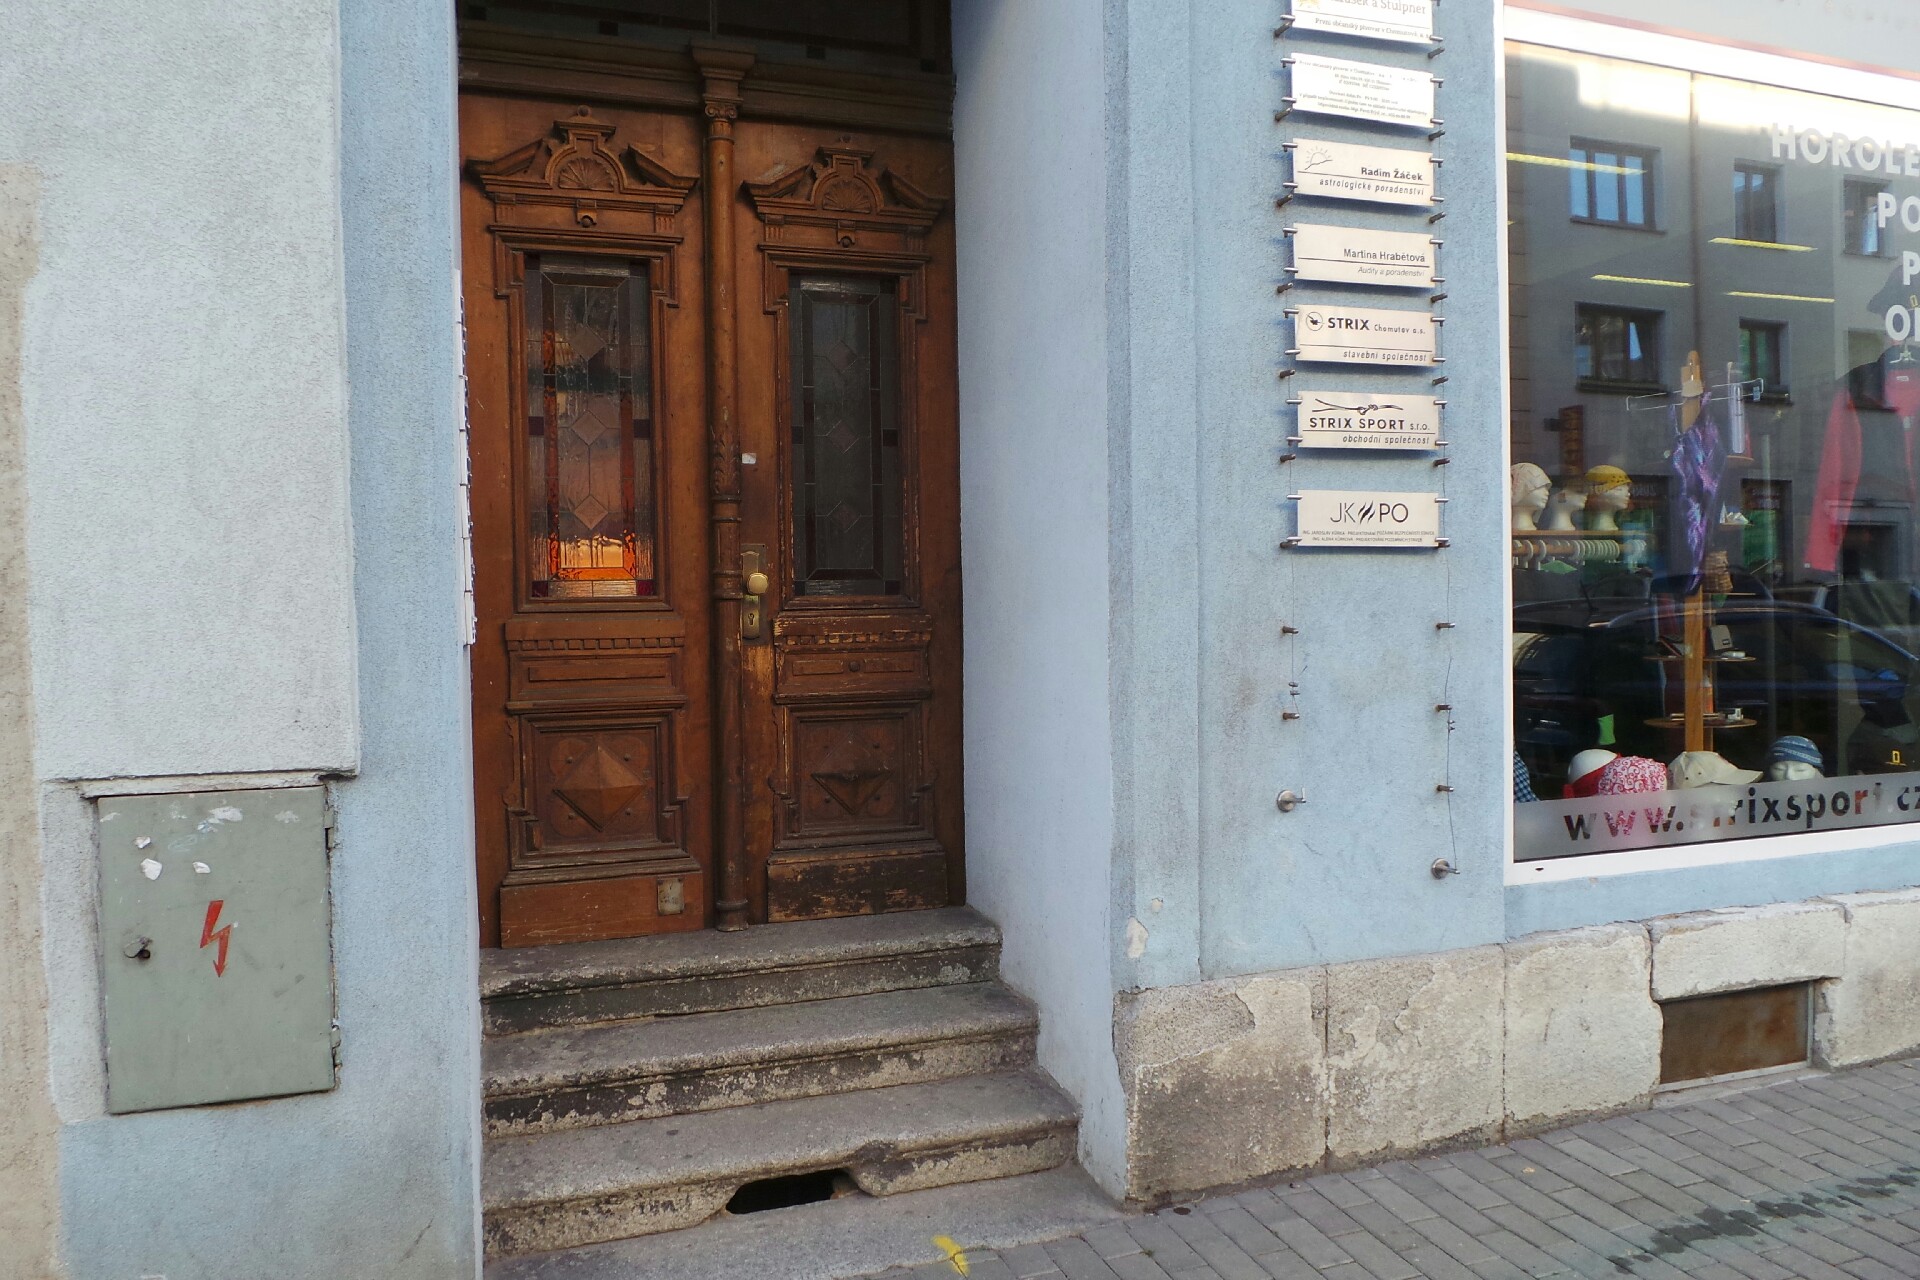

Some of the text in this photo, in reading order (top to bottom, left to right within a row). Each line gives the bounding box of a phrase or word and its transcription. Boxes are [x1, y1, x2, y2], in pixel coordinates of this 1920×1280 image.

[1771, 123, 1920, 177] HOROLE
[1360, 167, 1423, 181] Radim Žáček
[1319, 179, 1425, 196] astrologické poradenství
[1877, 192, 1920, 233] PO
[1343, 248, 1377, 260] Martina
[1327, 317, 1370, 331] STRIX
[1374, 323, 1410, 334] Chomutov
[1343, 350, 1427, 363] stavební společnost
[1309, 417, 1431, 431] STRIX SPORT s.r.o.
[1342, 434, 1430, 446] obchodní společnost
